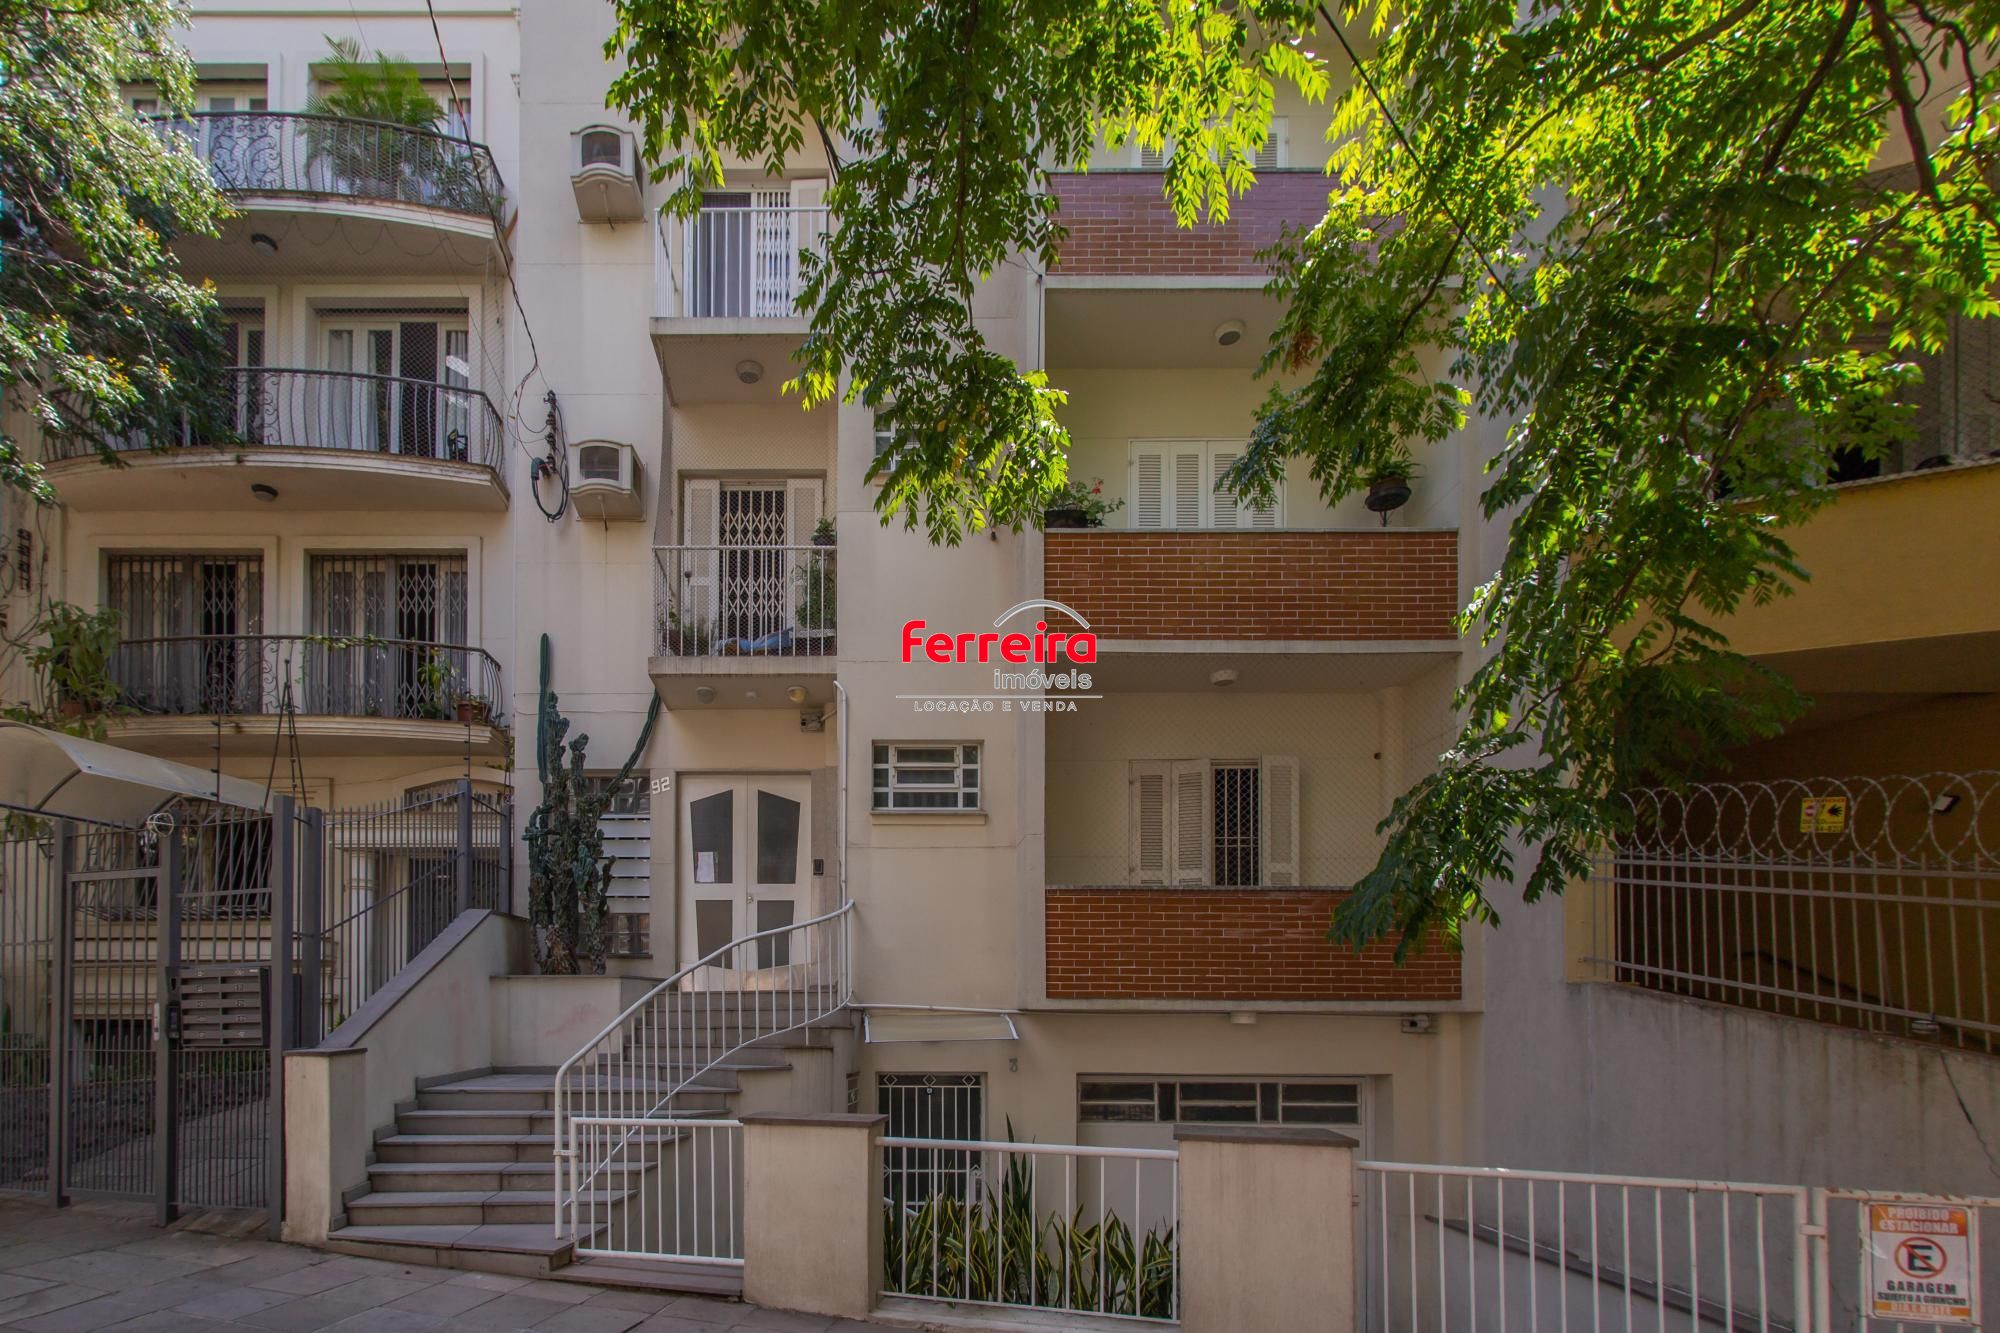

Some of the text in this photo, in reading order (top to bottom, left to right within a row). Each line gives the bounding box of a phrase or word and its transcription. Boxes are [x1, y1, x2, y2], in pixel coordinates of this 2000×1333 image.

[651, 776, 670, 795] 92
[1888, 1207, 1950, 1221] PROIBIDO
[1887, 1280, 1957, 1295] GARAGEM
